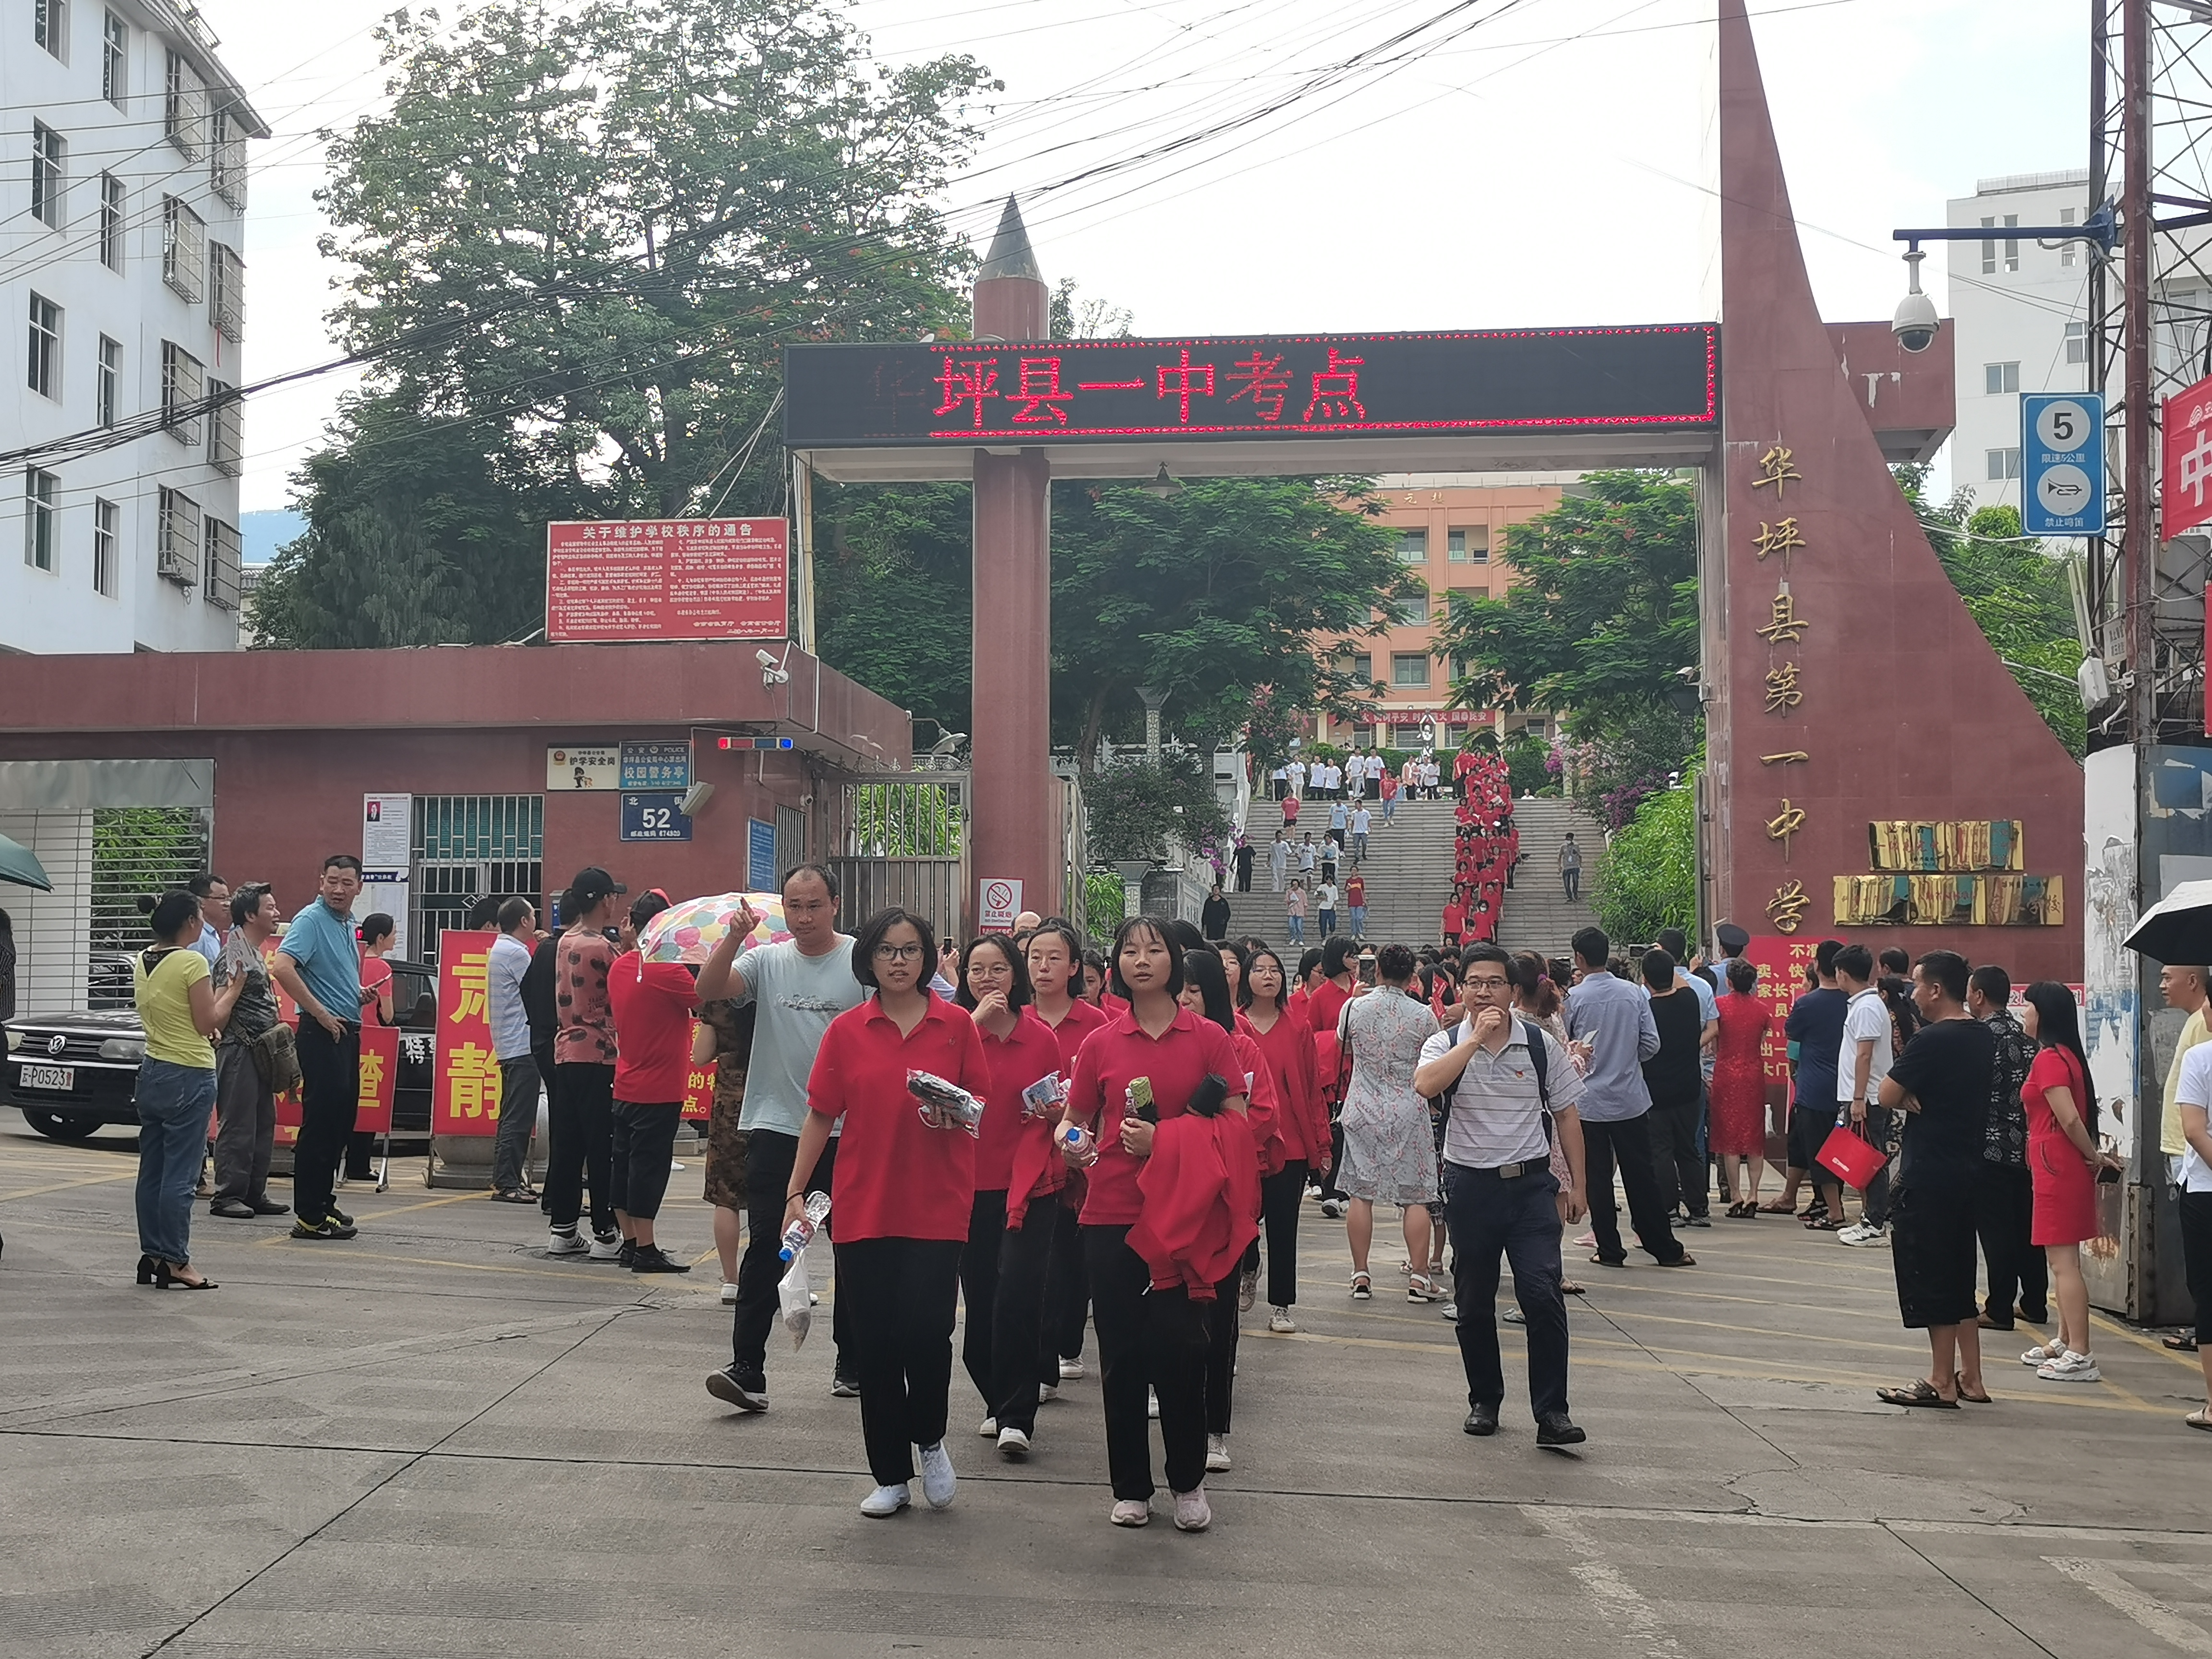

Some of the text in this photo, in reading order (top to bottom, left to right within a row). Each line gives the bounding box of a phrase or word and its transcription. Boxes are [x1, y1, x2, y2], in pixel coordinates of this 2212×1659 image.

[2053, 412, 2074, 440] 5
[582, 523, 753, 539] 关于维护学校秩序的通告
[1751, 445, 1810, 934] 华坪县第一中学
[642, 808, 671, 828] 52
